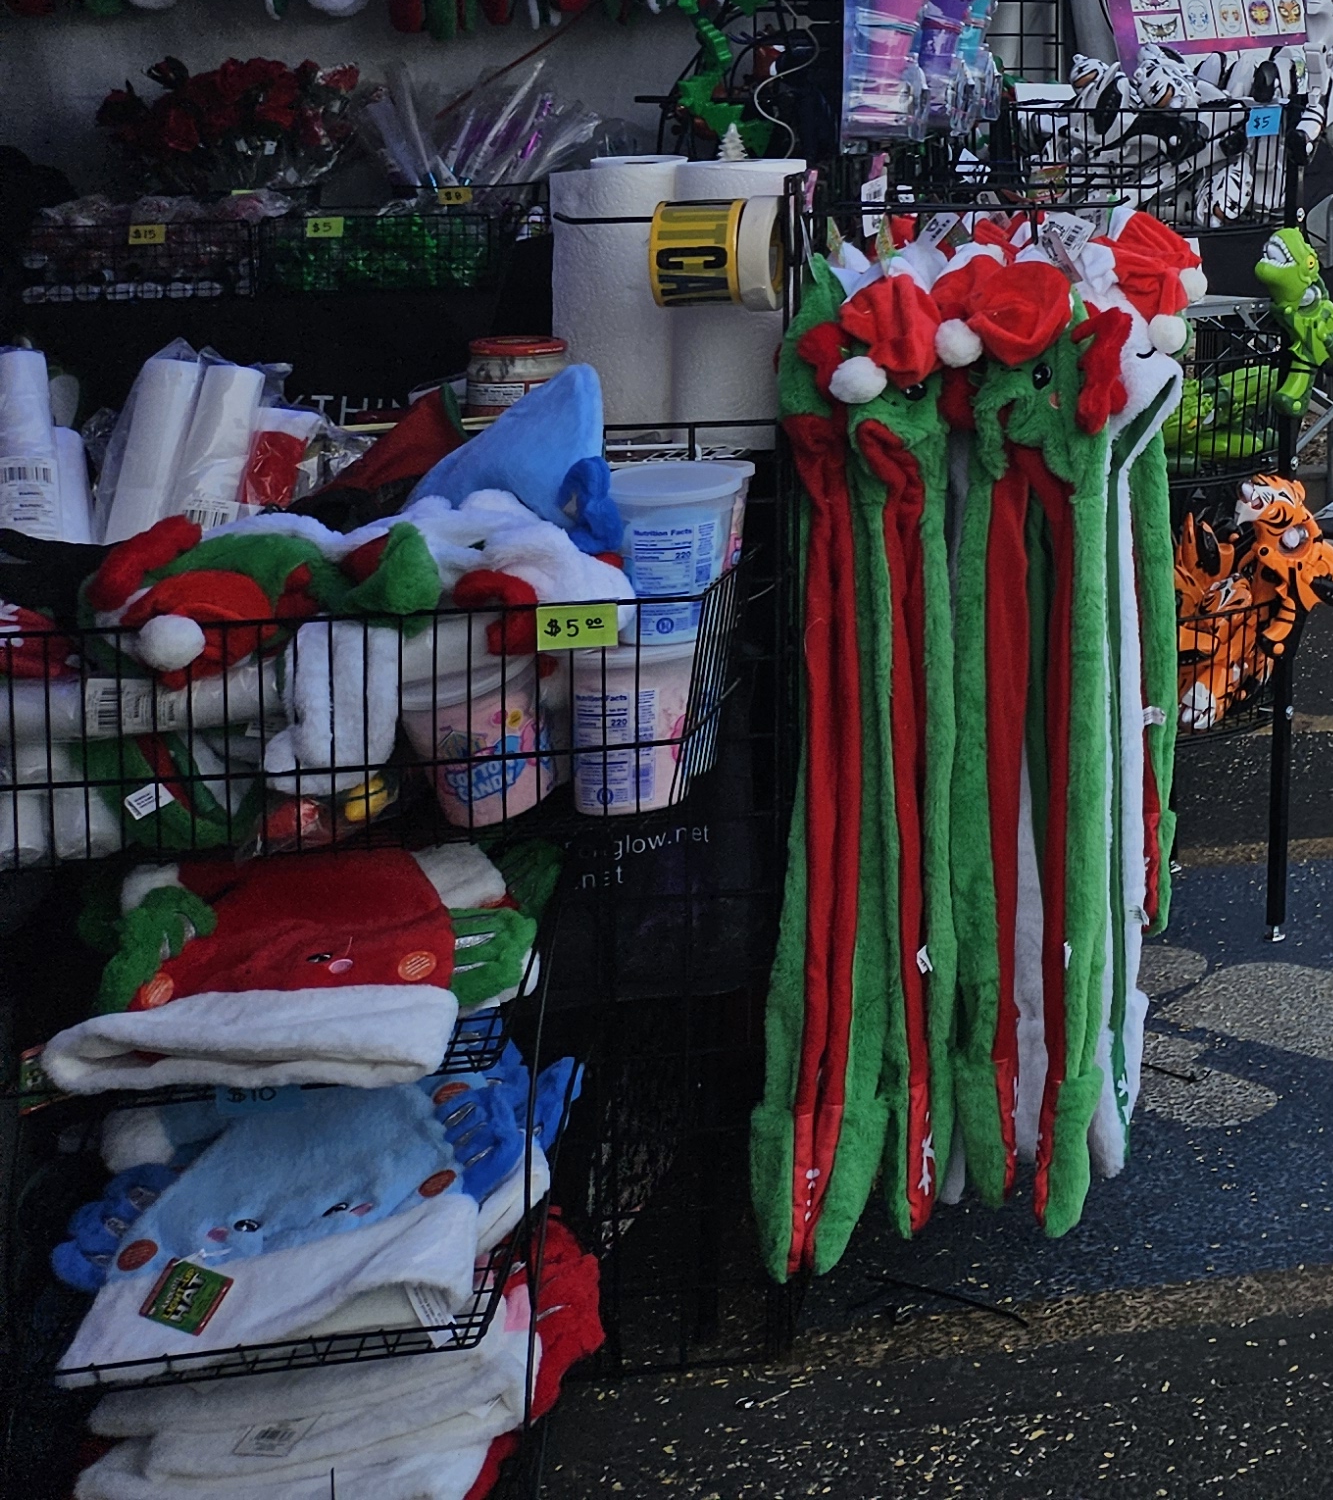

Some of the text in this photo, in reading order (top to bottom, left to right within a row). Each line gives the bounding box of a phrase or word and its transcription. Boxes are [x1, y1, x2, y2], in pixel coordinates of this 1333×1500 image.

[1253, 116, 1271, 129] $5
[312, 222, 332, 233] $5
[671, 528, 693, 536] Facts
[675, 551, 691, 560] 220
[611, 718, 628, 728] 220
[226, 1086, 277, 1104] $10
[169, 1272, 206, 1323] HAT
